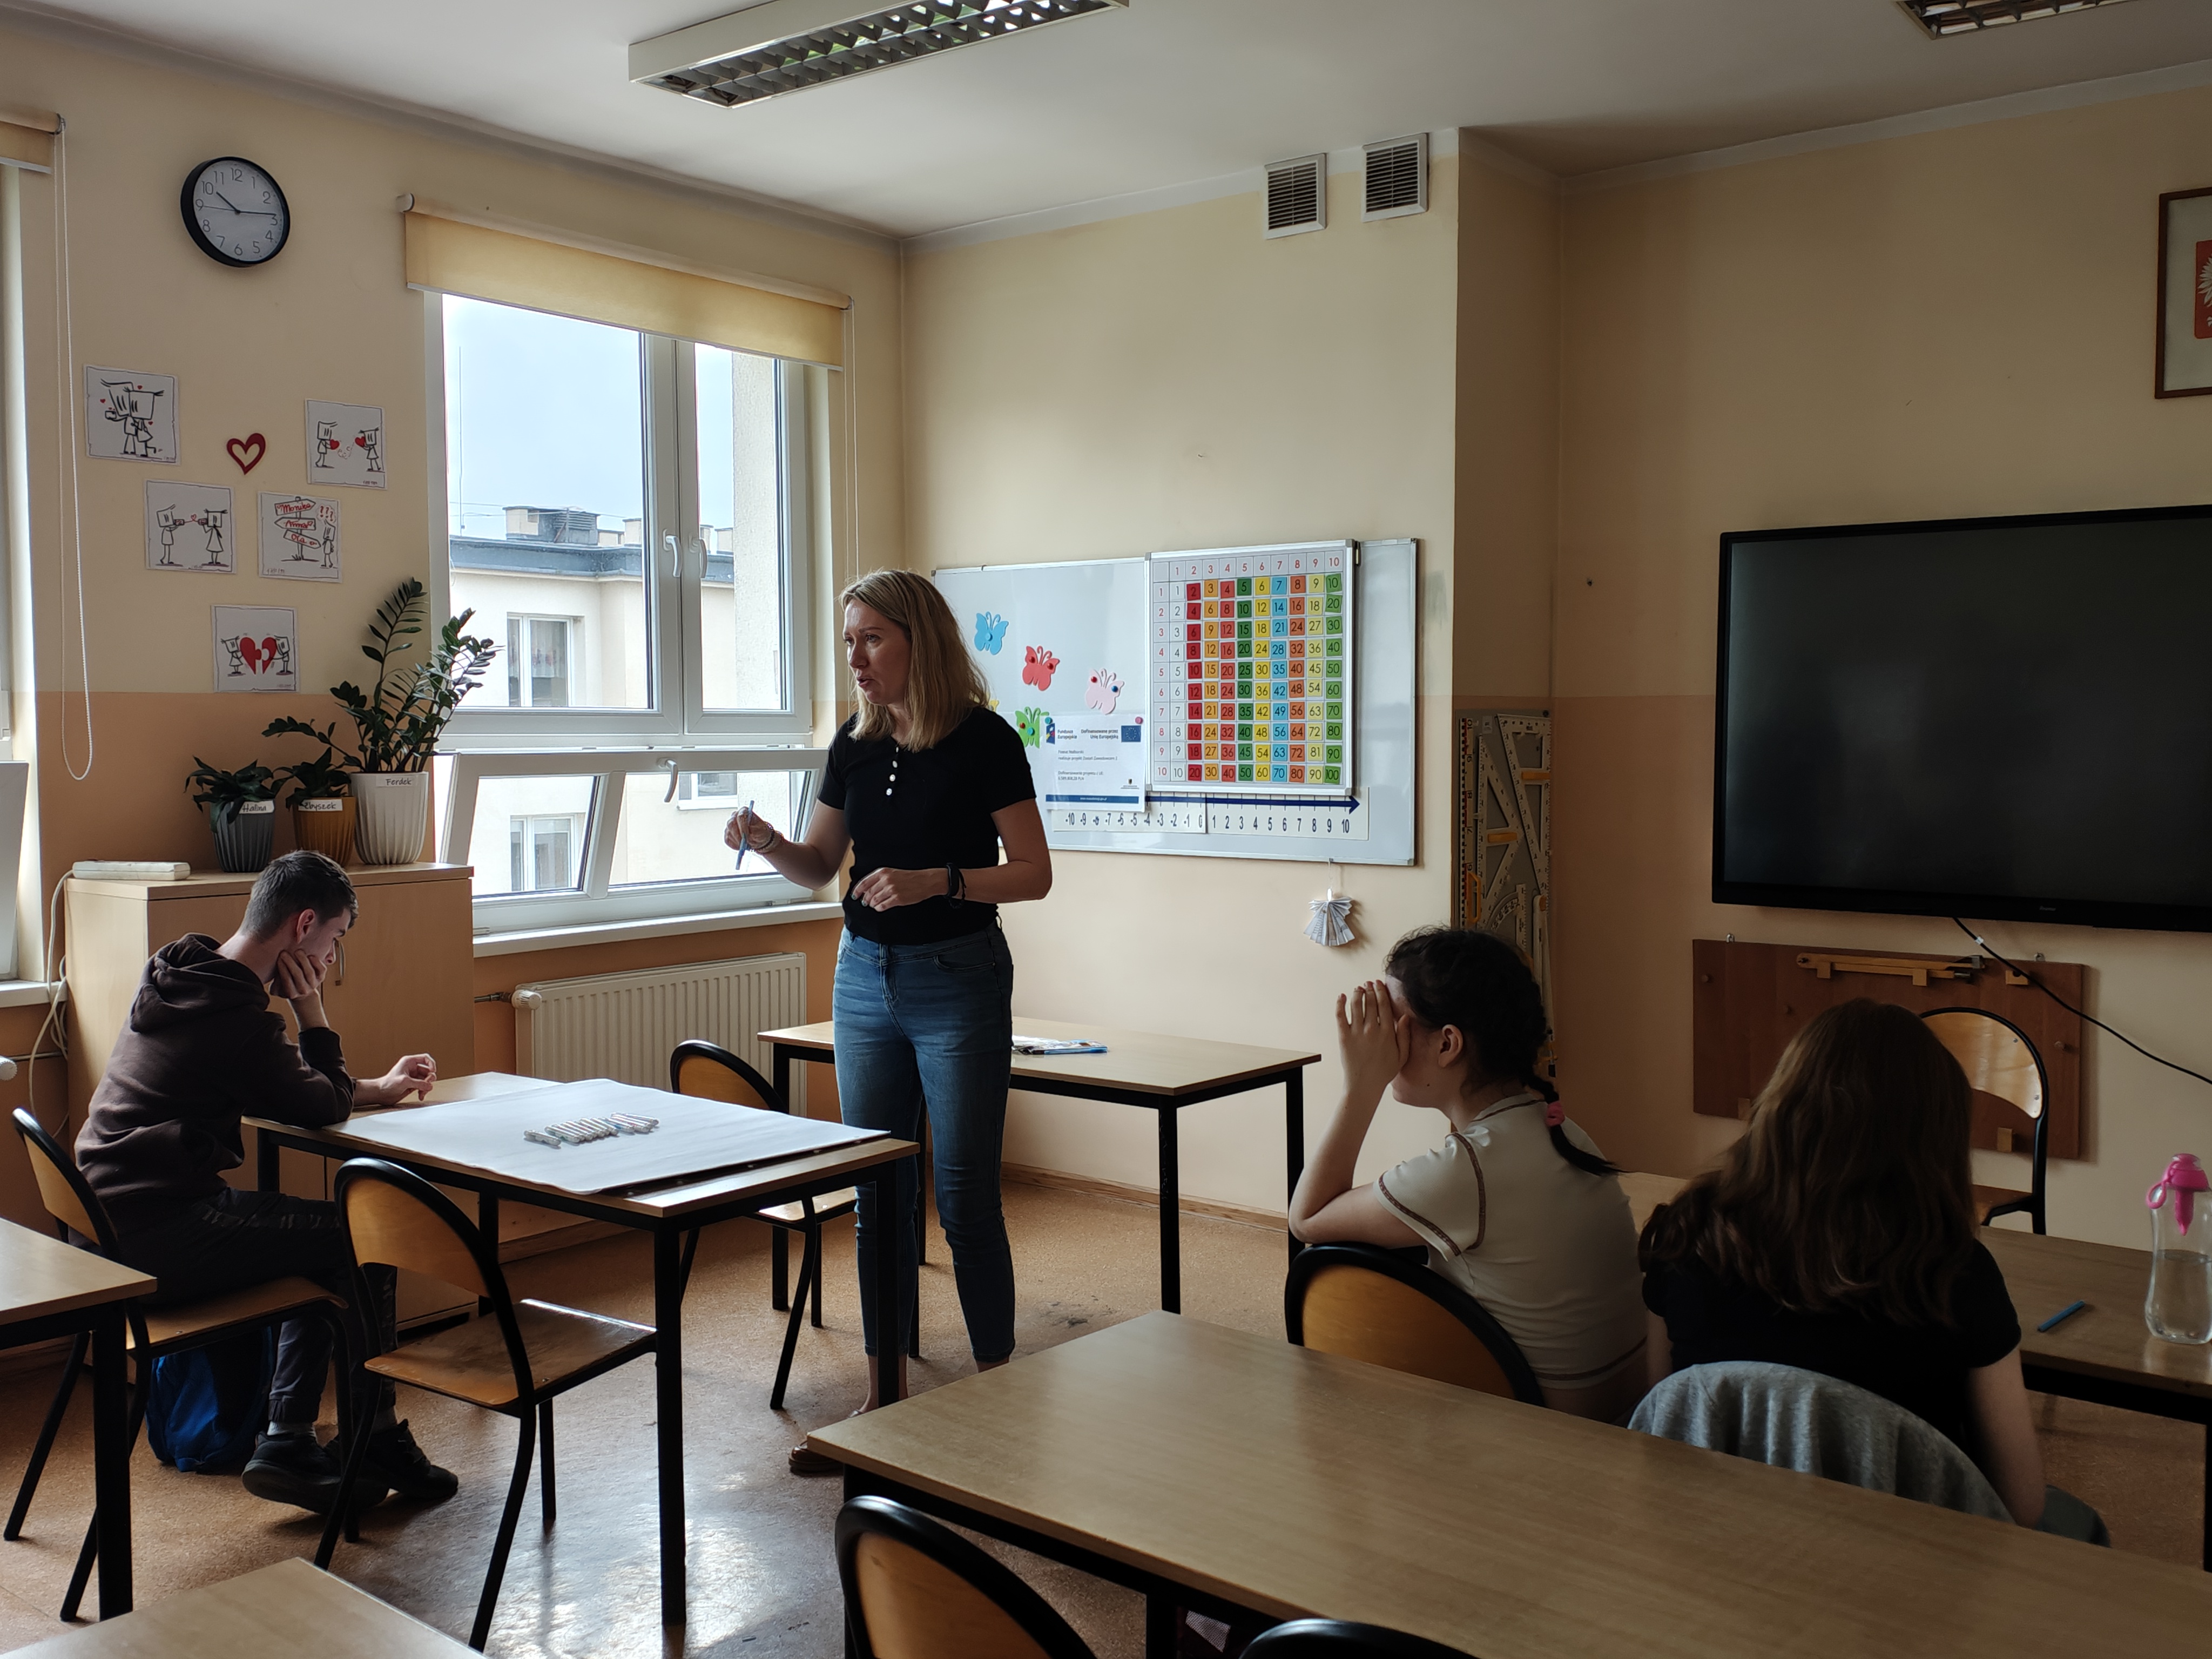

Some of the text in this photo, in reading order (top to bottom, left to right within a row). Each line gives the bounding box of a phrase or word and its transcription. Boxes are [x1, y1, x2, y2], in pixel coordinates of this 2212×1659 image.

[214, 171, 224, 185] 11
[231, 167, 242, 182] 12
[201, 180, 214, 195] 10
[252, 176, 255, 189] 1
[262, 191, 271, 204] 2
[195, 199, 204, 211] 9
[203, 219, 211, 232] 8
[270, 213, 278, 226] 3
[216, 235, 225, 248] 7
[265, 230, 273, 242] 4
[234, 244, 243, 255] 6
[253, 241, 260, 253] 5
[281, 502, 311, 513] Monika
[1176, 557, 1340, 576] 1 2 3 4 5 6 7 8 9 10
[1159, 577, 1338, 597] 1 1 3 6 7 8 9 10
[1159, 598, 1340, 617] 2 2 6 12 14 16 18 20
[1159, 619, 1340, 637] 3 3 9 18 21 24 27 30
[1159, 642, 1340, 657] 4 4 12 24 28 32 36 40
[1159, 663, 1340, 677] 5 5 15 30 35 40 45 50
[1159, 682, 1340, 697] 6 6 18 36 42 48 54 60
[1159, 705, 1340, 717] 7 7 21 42 49 56 63 70
[1159, 725, 1340, 737] 8 8 24 48 56 64 72 80
[1467, 719, 1473, 730] 10
[1159, 746, 1340, 759] 9 9 27 54 63 72 81 90
[1158, 766, 1339, 780] 10 10 30 60 70 80 90 100
[386, 778, 412, 786] Ferdek
[304, 800, 336, 810] Zbyszek
[1065, 812, 1075, 825] -10
[1080, 813, 1087, 825] -9
[1105, 813, 1111, 825] -7
[1118, 812, 1124, 826] -6
[1131, 813, 1137, 826] -5
[1144, 813, 1150, 826] -4
[1157, 813, 1164, 826] -3
[1170, 813, 1177, 827] -2
[1184, 814, 1190, 827] -1
[1212, 815, 1216, 828] 1
[1225, 815, 1229, 829] 2
[1239, 816, 1243, 830] 3
[1253, 817, 1258, 830] 4
[1268, 817, 1272, 831] 5
[1283, 818, 1287, 831] 6
[1297, 818, 1301, 832] 7
[1312, 818, 1317, 832] 8
[1327, 818, 1332, 833] 9
[1341, 819, 1350, 833] 10
